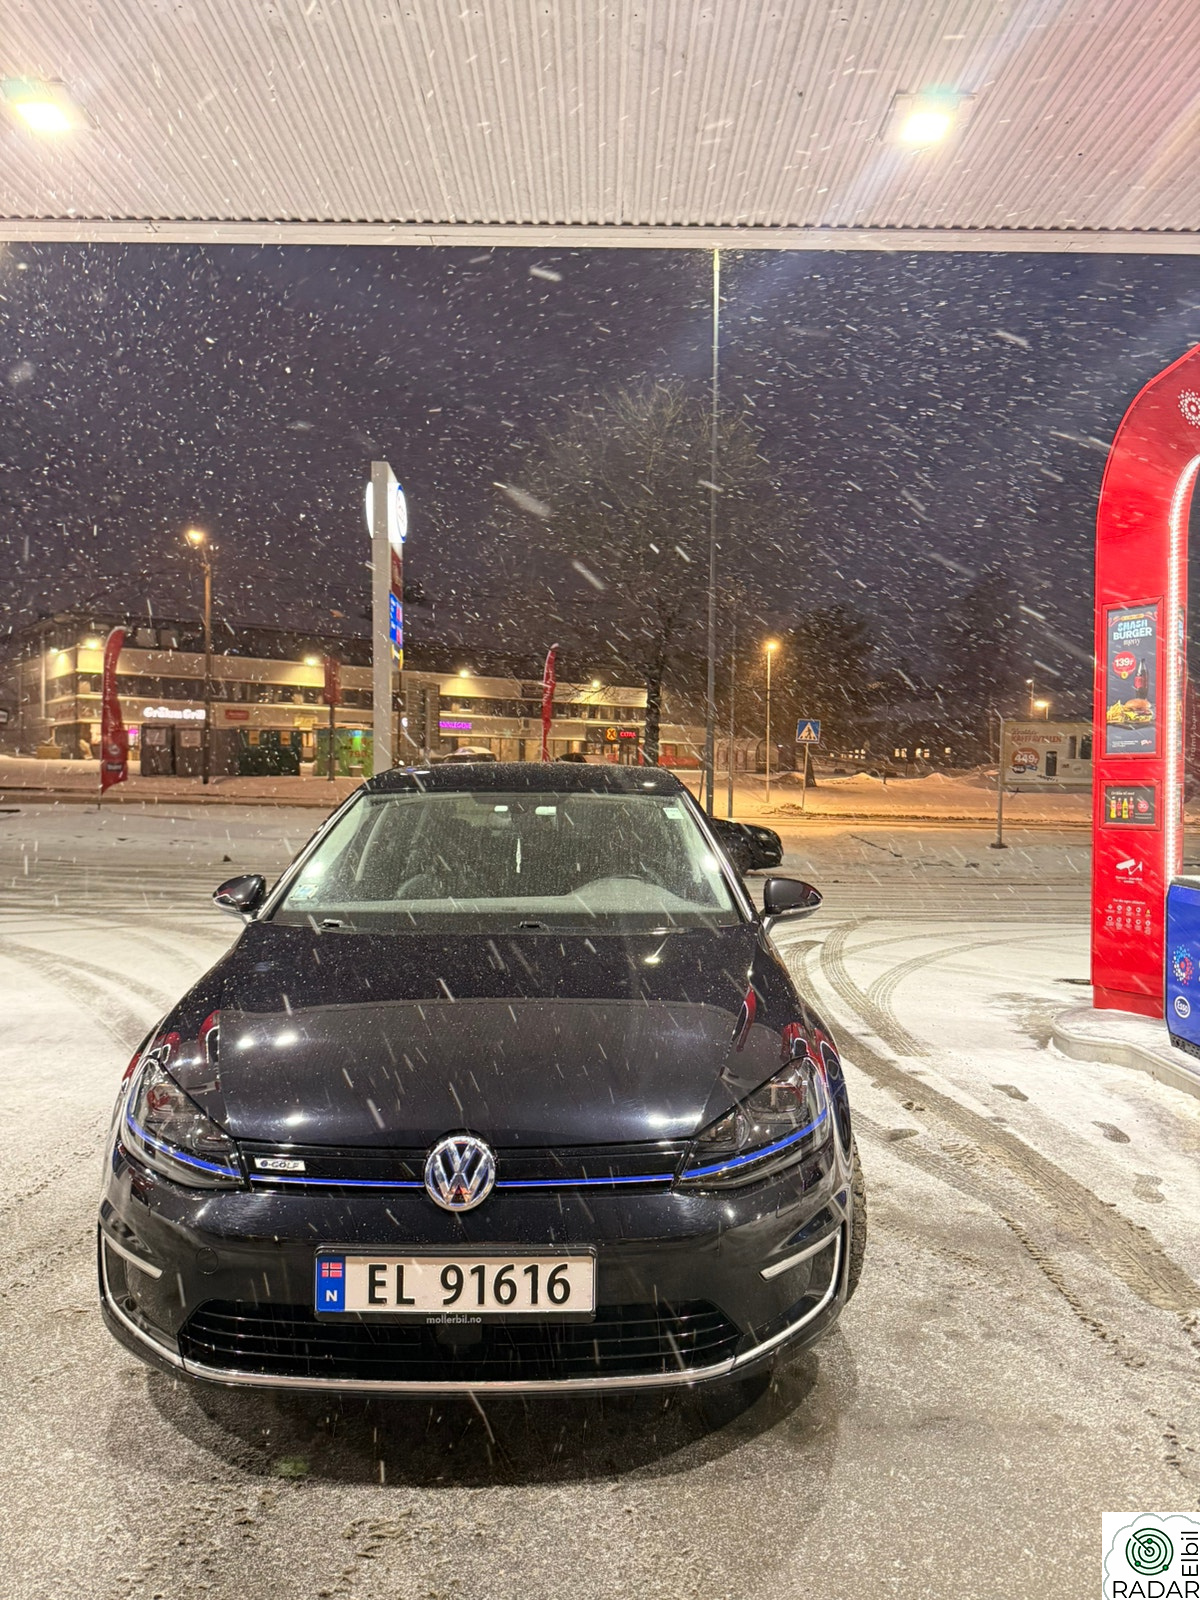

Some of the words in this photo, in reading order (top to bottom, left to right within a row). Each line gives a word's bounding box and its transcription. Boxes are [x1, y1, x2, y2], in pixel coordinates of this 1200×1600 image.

[1117, 619, 1148, 632] SMASH
[1113, 627, 1152, 640] BURGER
[367, 1264, 415, 1305] EL
[440, 1263, 571, 1305] 91616
[325, 1289, 338, 1302] N
[426, 1314, 482, 1324] mollerbil.no
